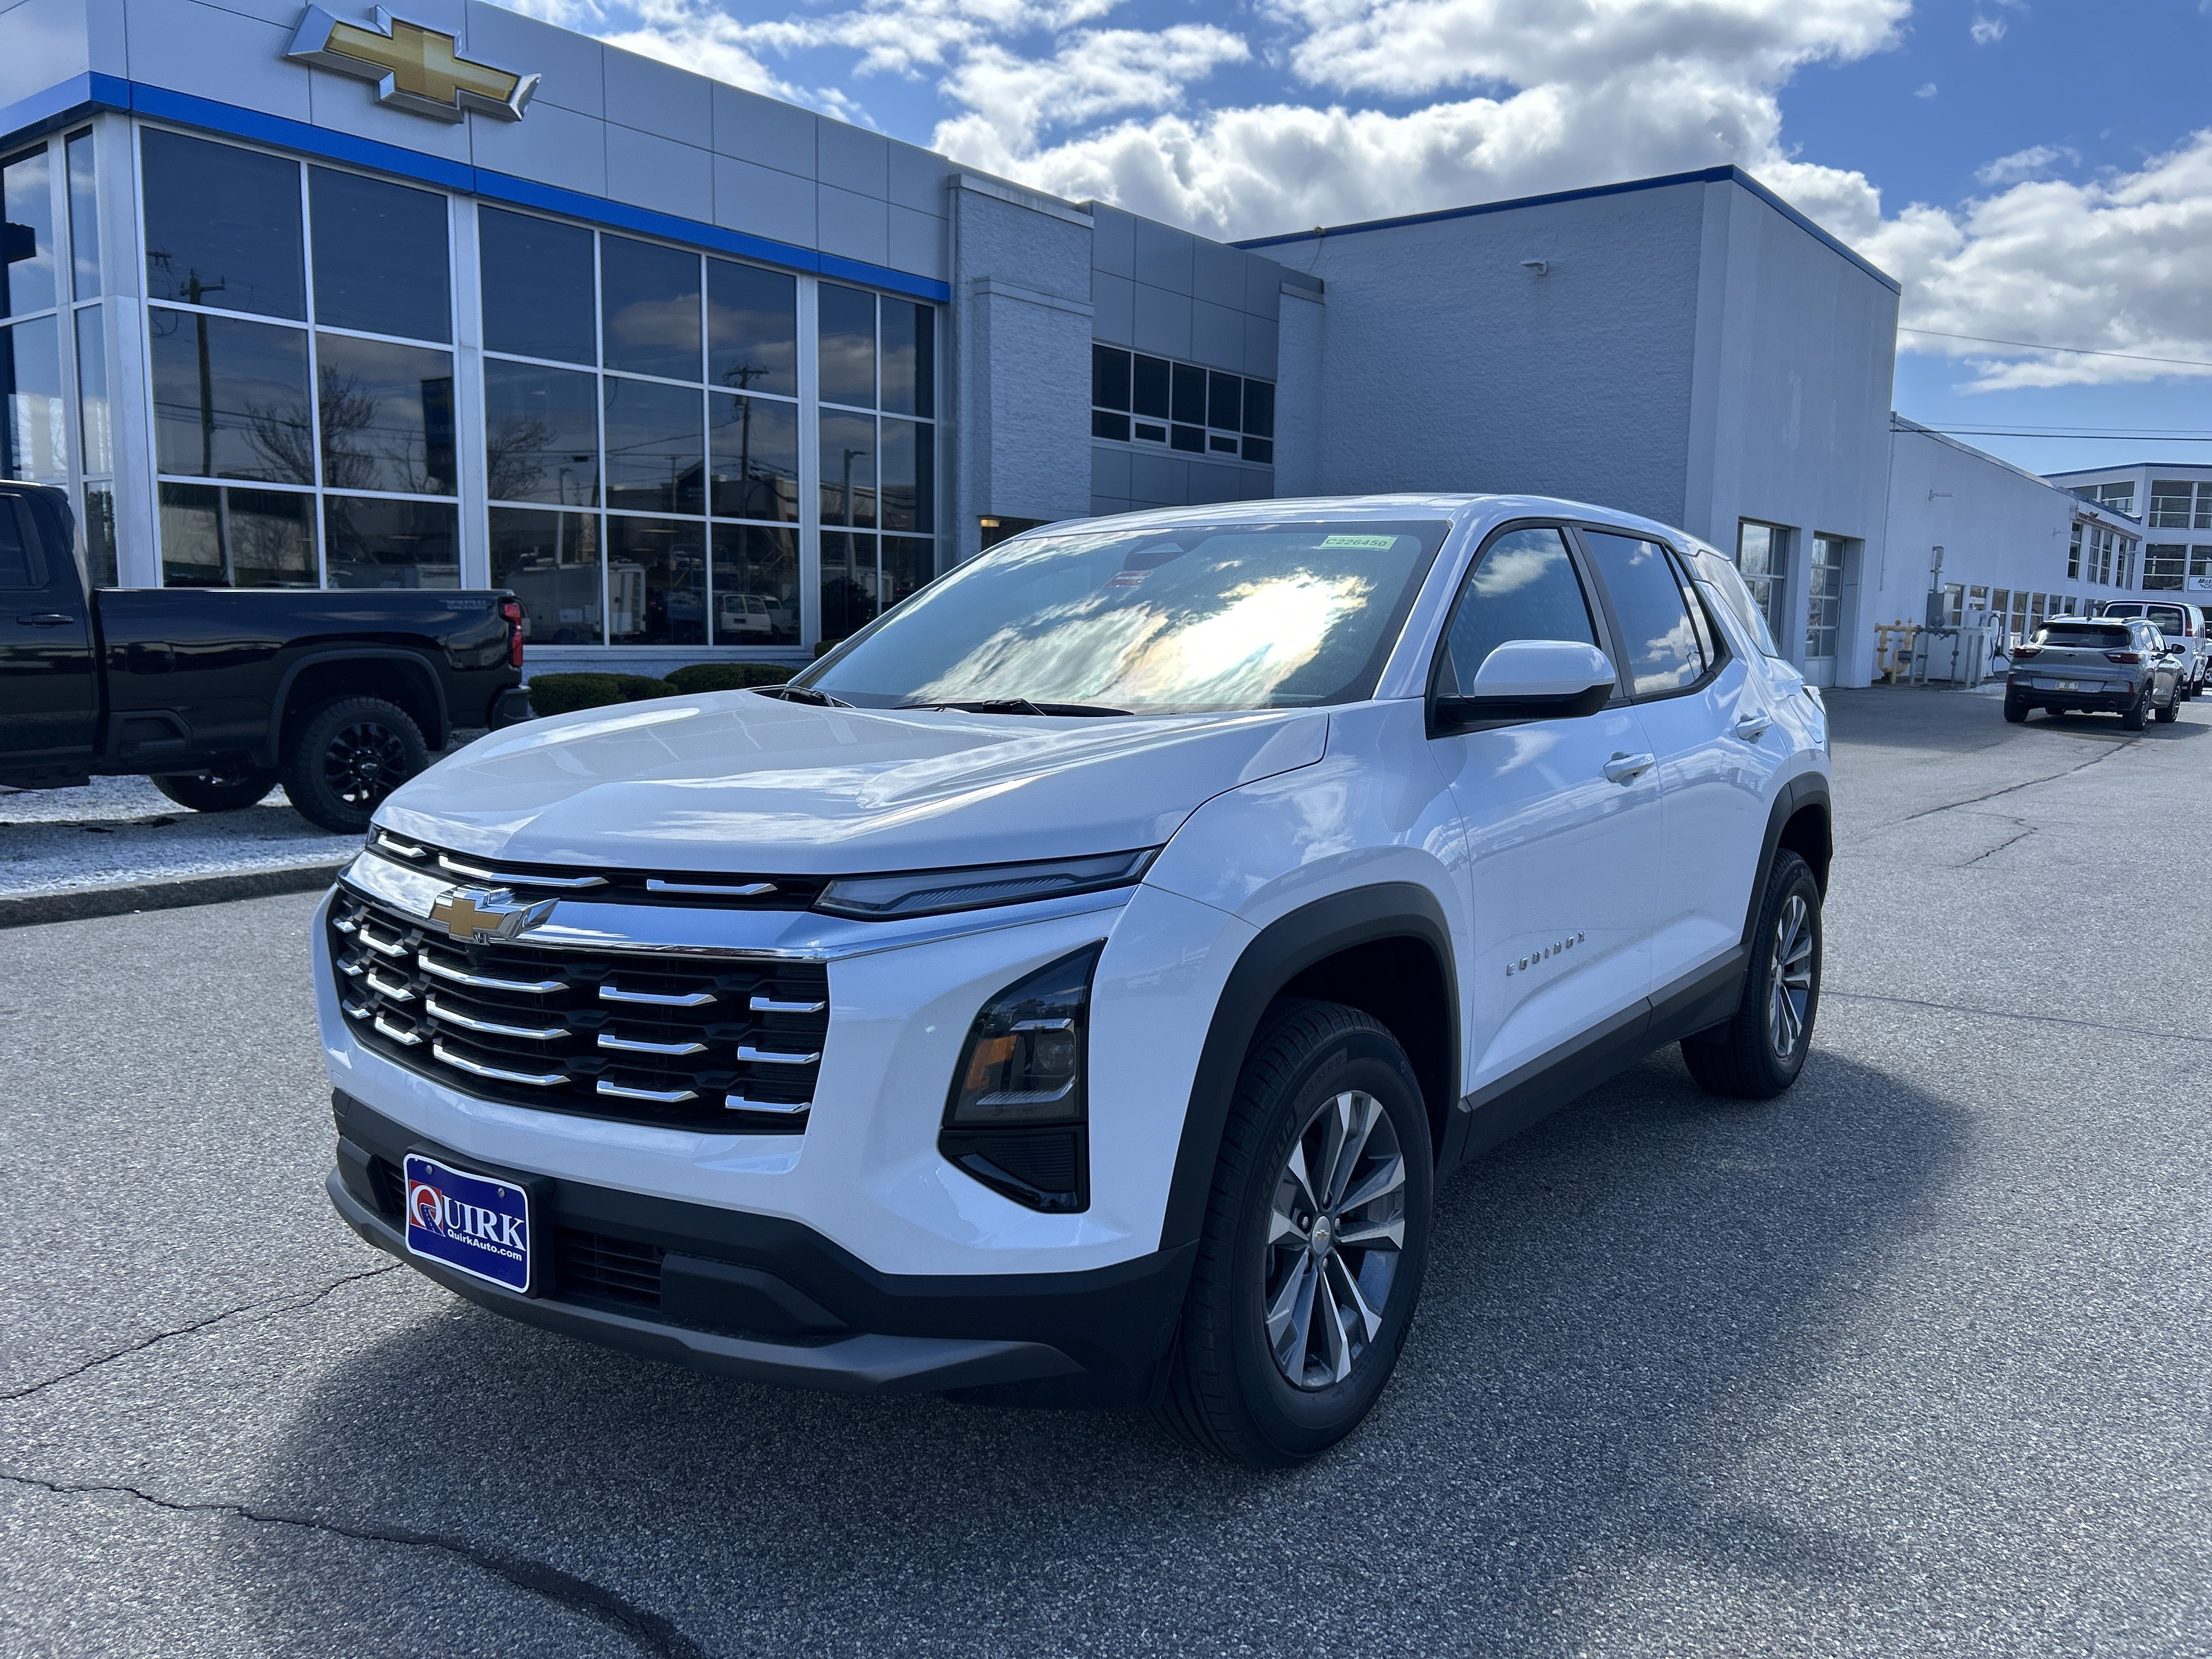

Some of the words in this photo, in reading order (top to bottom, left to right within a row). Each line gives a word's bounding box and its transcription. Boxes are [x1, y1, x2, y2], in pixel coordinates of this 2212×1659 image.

[1325, 538, 1387, 547] C226450
[1506, 930, 1586, 976] EQUINOX
[411, 1185, 526, 1251] QUIRK
[448, 1228, 522, 1261] QuirkAuto.com
